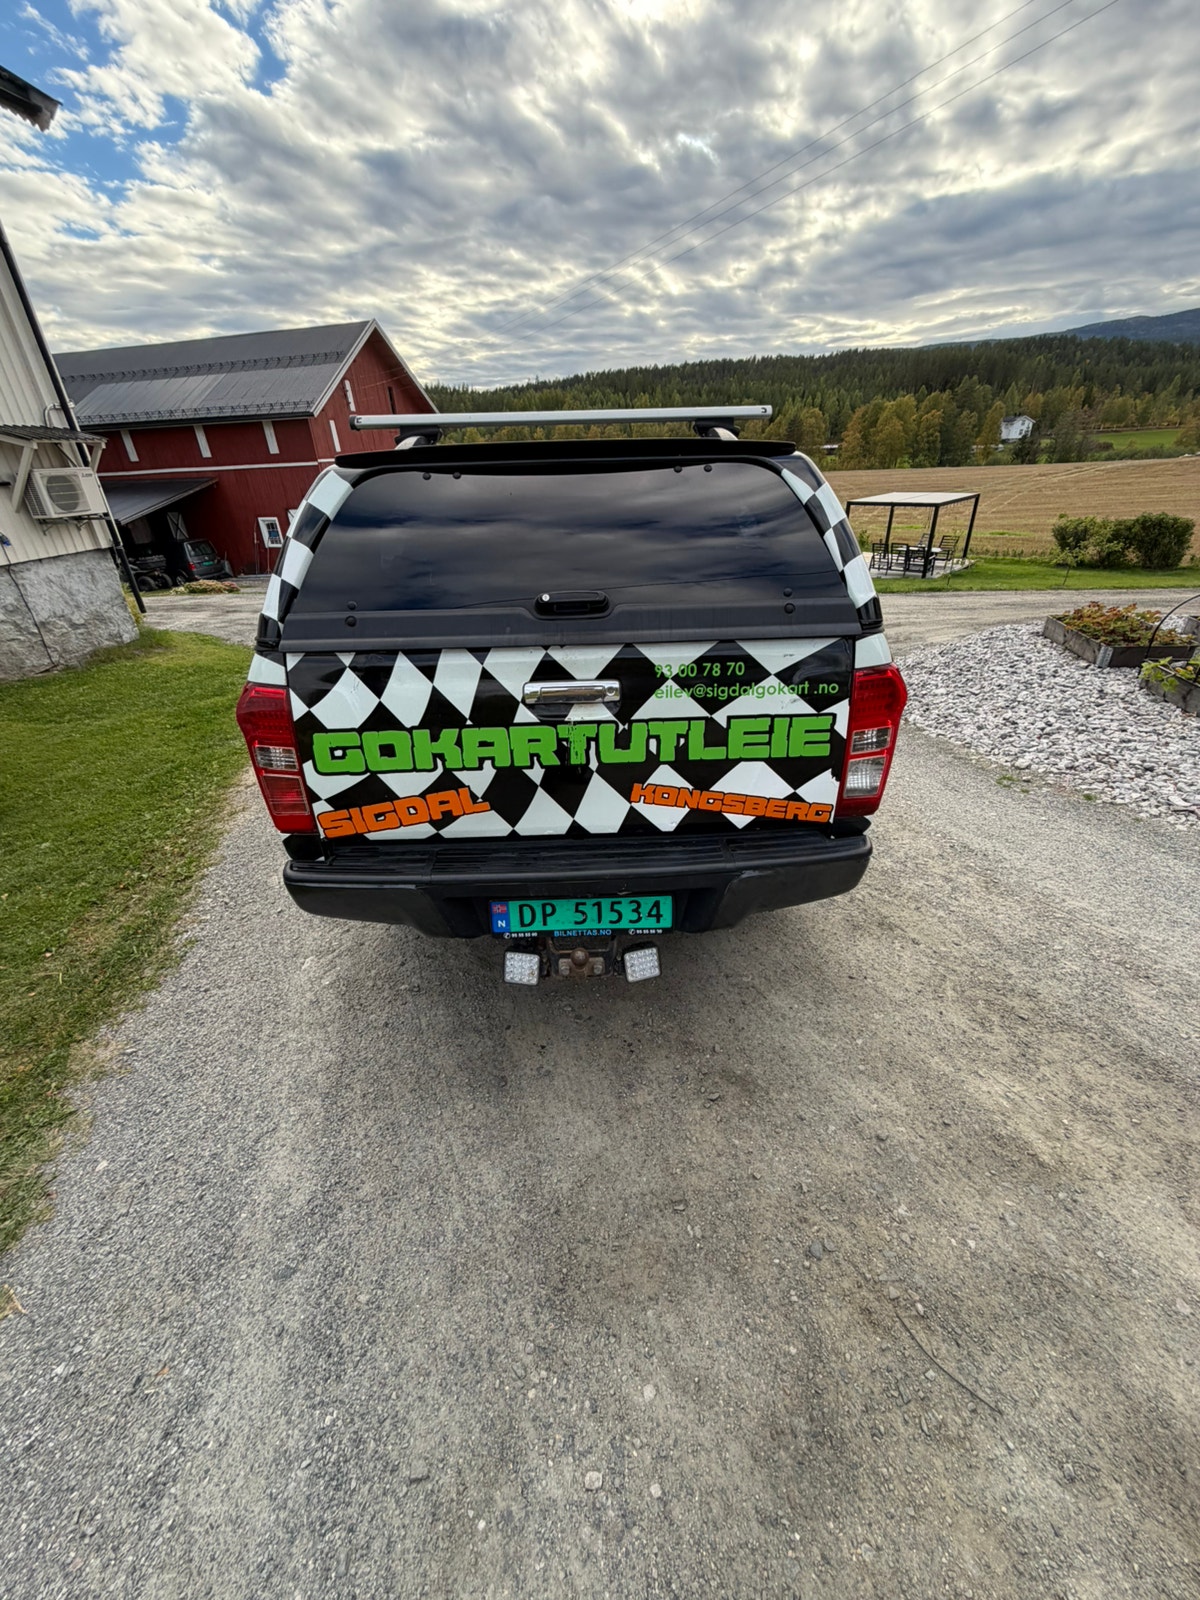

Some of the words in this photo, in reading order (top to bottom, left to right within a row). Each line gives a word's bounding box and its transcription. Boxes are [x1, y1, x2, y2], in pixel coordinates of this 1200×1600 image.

[655, 664, 673, 678] 93
[678, 664, 697, 678] 00
[702, 663, 721, 677] 78
[726, 662, 745, 676] 70
[312, 715, 834, 774] GOKARTUTLEIE
[317, 786, 491, 839] SIGDAL
[630, 783, 834, 823] KONGSBERG
[497, 920, 506, 928] N
[518, 903, 557, 928] DP
[574, 900, 663, 925] 51534
[553, 929, 612, 937] BILNETTAS.NO
